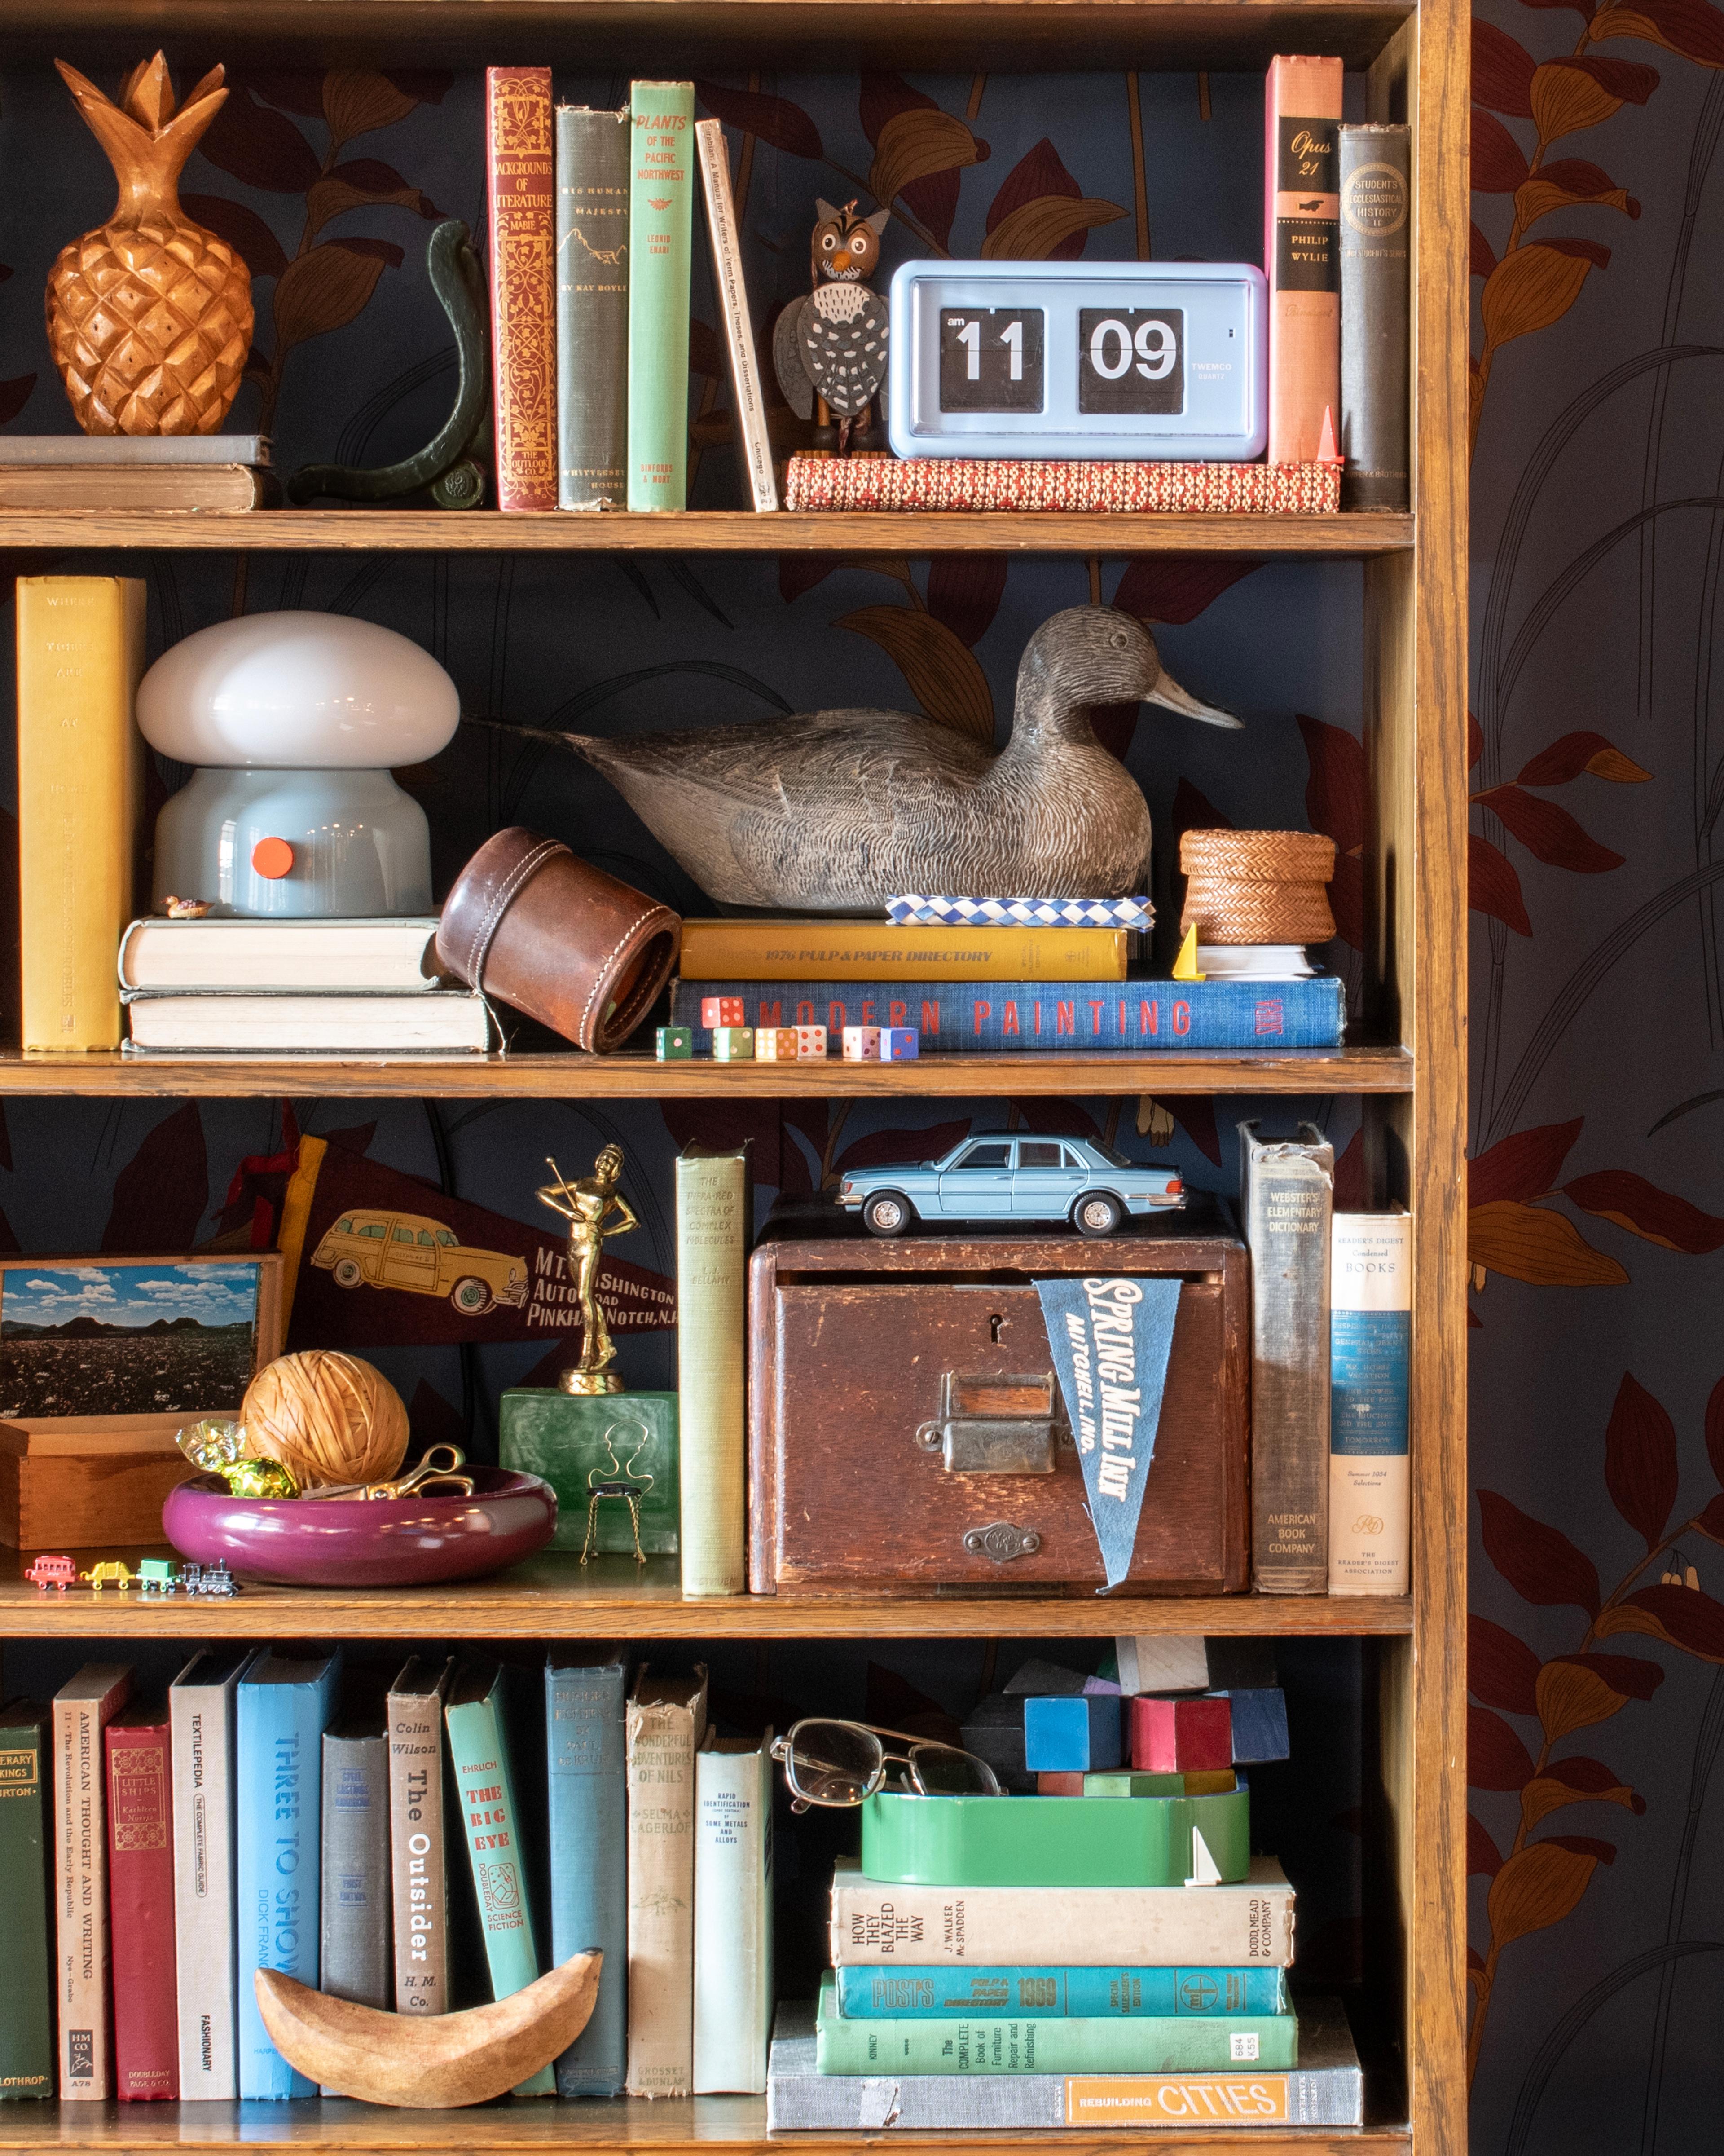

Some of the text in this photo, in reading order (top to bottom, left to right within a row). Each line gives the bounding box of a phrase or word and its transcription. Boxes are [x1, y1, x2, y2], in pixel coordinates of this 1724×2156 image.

[636, 115, 686, 130] PLANTS
[647, 136, 675, 146] OF THE
[1291, 130, 1332, 159] Opus
[646, 152, 675, 163] PACIFIC
[638, 170, 684, 180] NORTHWEST
[1299, 161, 1319, 176] 21
[516, 178, 528, 191] OF
[1355, 180, 1398, 189] STUDENT'S
[1357, 208, 1397, 217] HISTORY
[510, 220, 536, 230] MABIE
[1292, 236, 1328, 245] PHILIP
[1292, 252, 1328, 262] WYLIE
[712, 172, 722, 200] Manual
[719, 216, 728, 244] Writers
[729, 279, 737, 309] Papers,
[742, 361, 754, 412] Dissertations
[947, 317, 965, 326] am
[1090, 319, 1176, 380] 09
[512, 459, 548, 468] OUTLOOK
[641, 464, 673, 472] BINFORDS
[765, 950, 992, 961] 1976 PULP PAPER DIRECTORY
[760, 1001, 1191, 1036] MODERN PAINTING
[1256, 999, 1283, 1036] SKIRA
[700, 1177, 718, 1186] THE
[1270, 1192, 1318, 1203] WEBSTER'S
[1267, 1207, 1321, 1217] ELEMENTARY
[690, 1222, 731, 1230] COMPLEX
[1269, 1222, 1319, 1232] DICTIONARY
[535, 1247, 567, 1280] MT.
[1346, 1263, 1396, 1273] BOOKS
[534, 1278, 577, 1301] AUTO
[1082, 1278, 1143, 1502] SPRING MILL INN
[1268, 1514, 1316, 1524] AMERICAN
[1278, 1529, 1306, 1539] BOOK
[1269, 1543, 1315, 1554] COMPANY
[396, 1723, 430, 1733] Colin
[650, 1718, 674, 1729] THE
[192, 1714, 203, 1788] TEXTILEPEDIA
[392, 1744, 436, 1754] Wilson
[462, 1761, 497, 1774] EHRLICH
[122, 1777, 156, 1786] LITTLE
[639, 1770, 682, 1783] OF NILS
[122, 1788, 156, 1796] SHIPS
[466, 1785, 502, 1804] THE
[470, 1808, 506, 1827] BIG
[642, 1809, 680, 1819] SELMA
[80, 1712, 93, 1980] AMERICAN THOUGHT AND WRITING
[475, 1832, 510, 1851] EYE
[275, 1731, 300, 1977] THREE TO SHOW
[408, 1770, 432, 1961] The Outsider
[65, 1874, 74, 1918] Republic
[479, 1863, 493, 1912] DOUBLEDAY
[258, 1890, 269, 1922] DICK
[488, 1910, 522, 1922] SCIENCE
[944, 1905, 953, 1944] WALKER
[1262, 1900, 1271, 1946] COMPANY
[489, 1919, 524, 1931] FICTION
[853, 1913, 865, 1944] HOW
[866, 1914, 880, 1945] THEY
[881, 1903, 894, 1953] BLAZED
[896, 1917, 909, 1940] THE
[910, 1915, 924, 1942] WAY
[1249, 1900, 1259, 1957] DODD, MEAD
[405, 1977, 436, 1986] H. M.
[410, 1996, 429, 2006] Co.
[873, 1978, 1057, 2007] POSTS 1969
[1133, 1978, 1141, 2007] EDITION
[202, 2015, 211, 2071] FASHIONARY
[869, 2033, 877, 2060] KINNEY
[943, 2040, 953, 2056] The
[959, 2023, 969, 2069] COMPLETE
[976, 2029, 985, 2063] Book of
[992, 2027, 1001, 2066] Furniture
[1025, 2023, 1036, 2068] Refinishing
[1235, 2037, 1244, 2057] 684
[1247, 2037, 1255, 2057] K55
[1008, 2041, 1019, 2068] Repair
[638, 2067, 683, 2075] GROSSET
[1080, 2098, 1152, 2108] REBUILDING
[1157, 2084, 1276, 2115] CITIES
